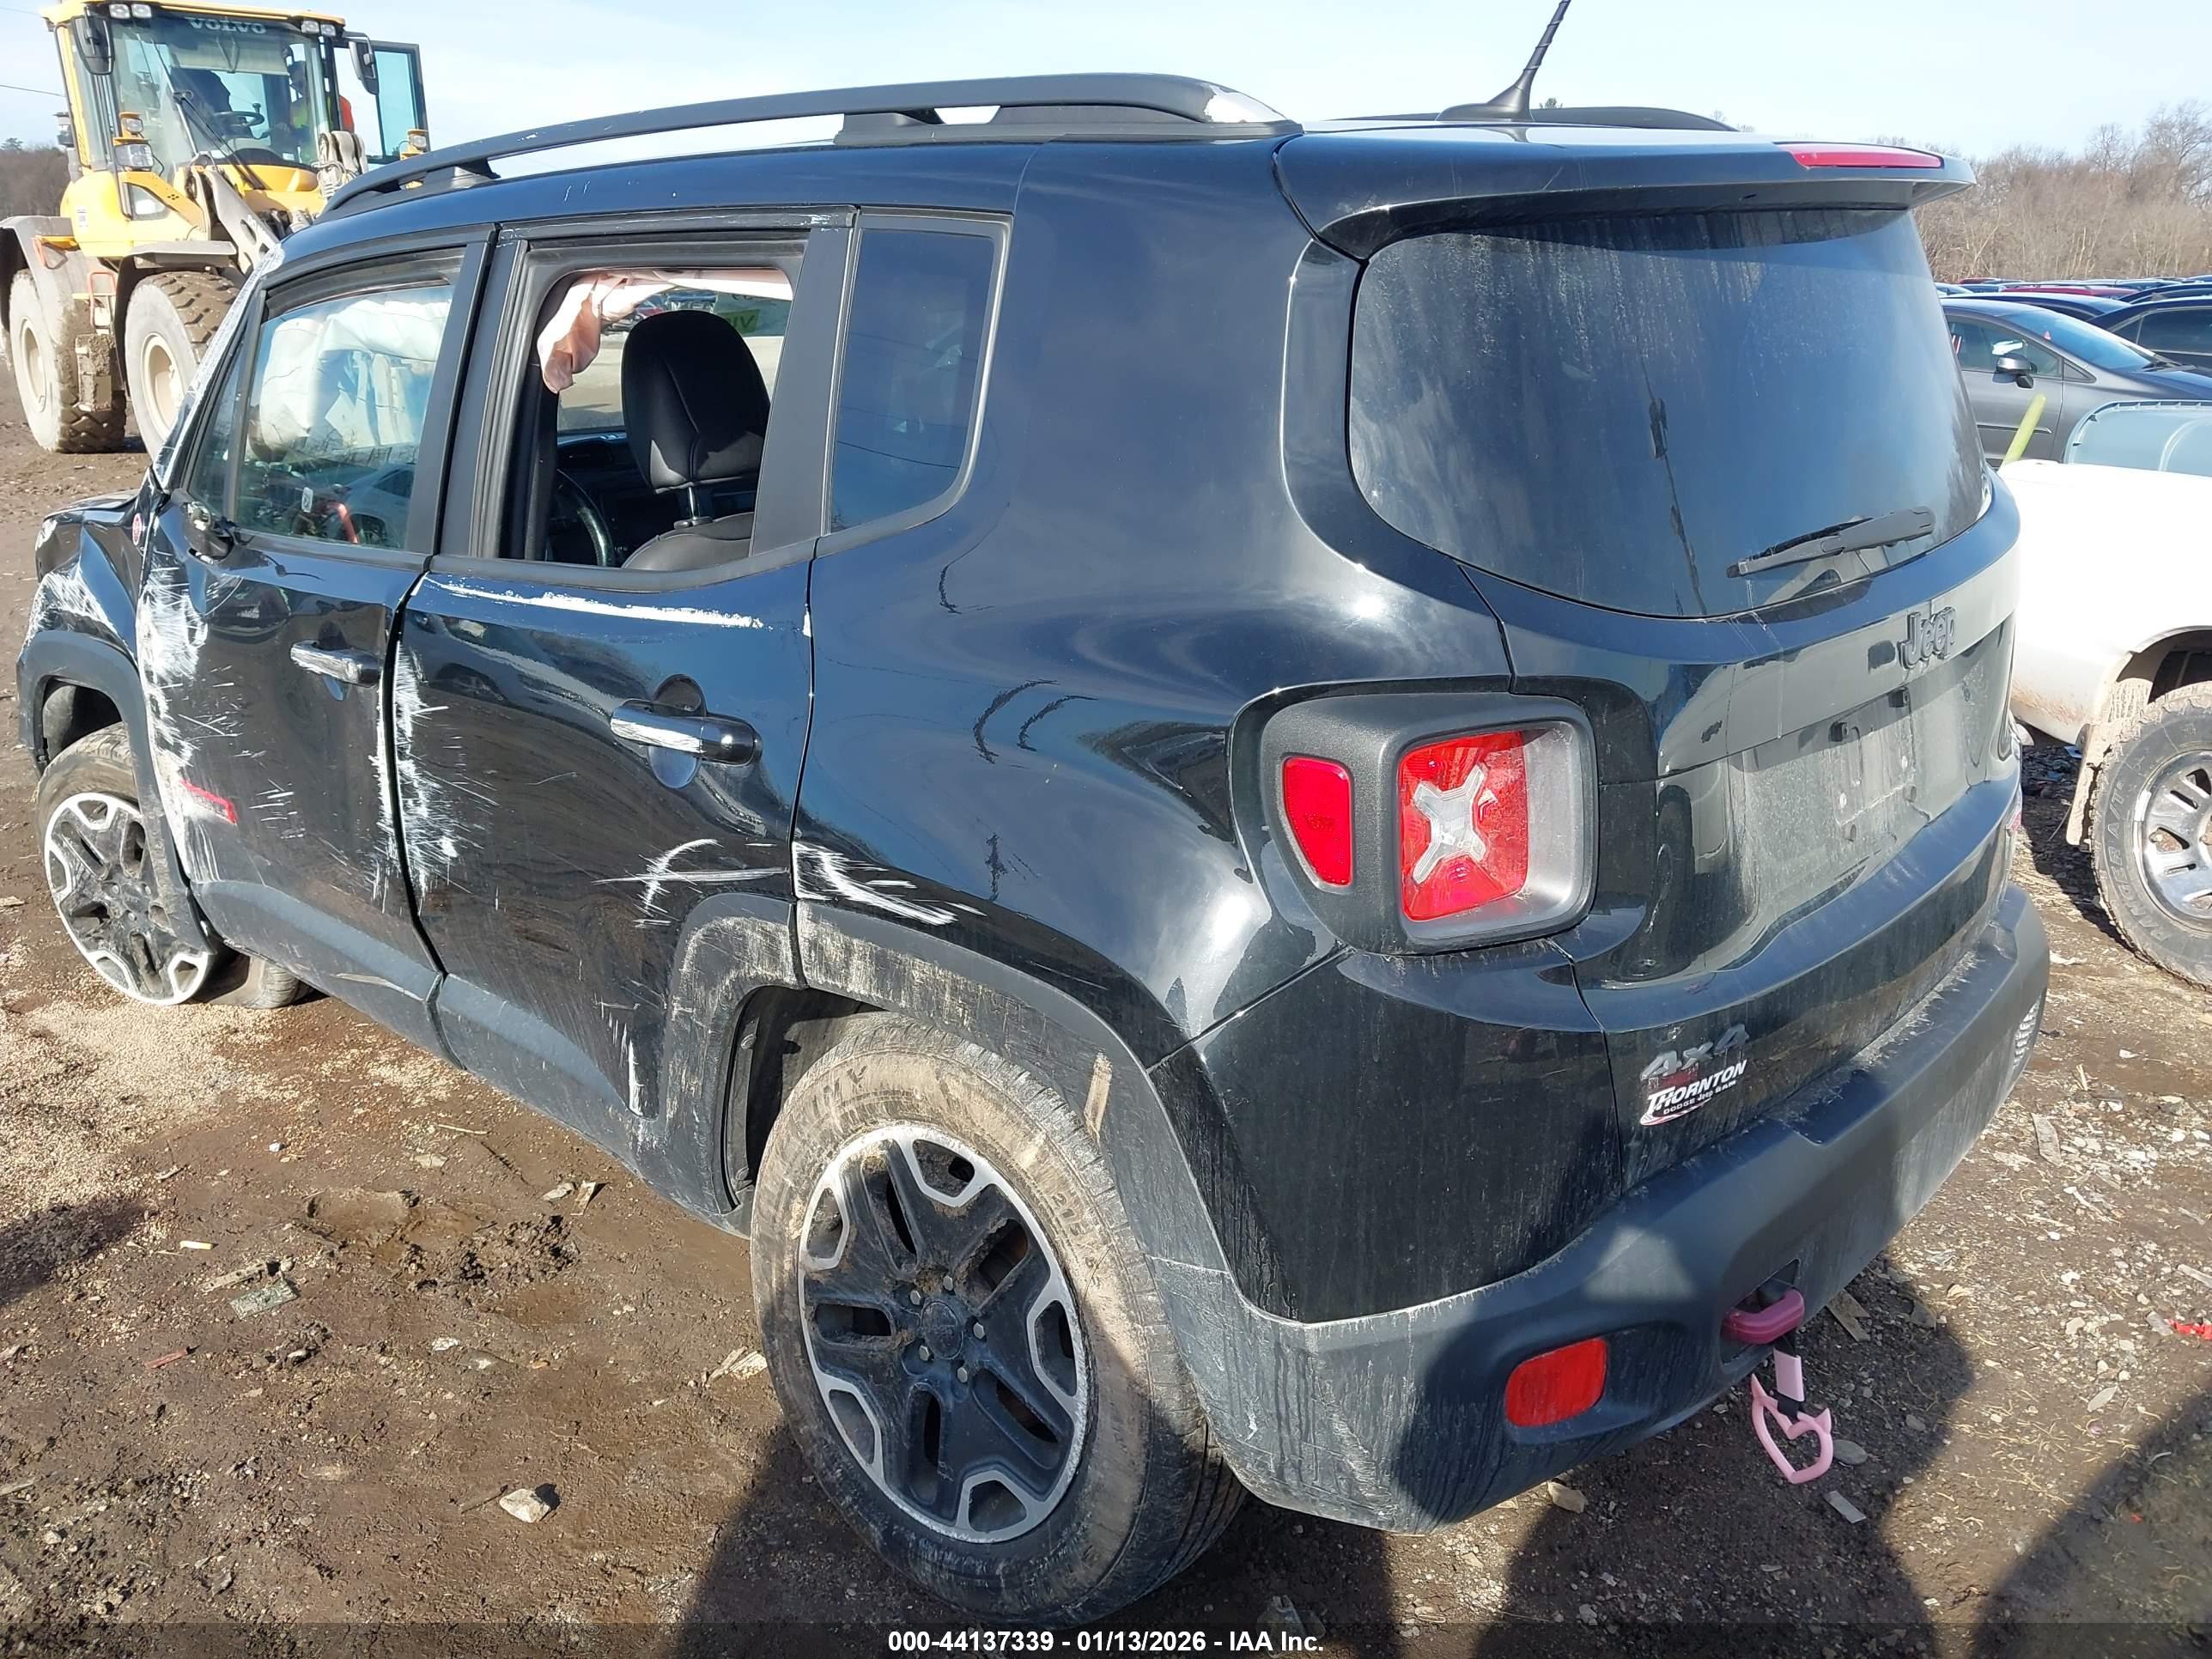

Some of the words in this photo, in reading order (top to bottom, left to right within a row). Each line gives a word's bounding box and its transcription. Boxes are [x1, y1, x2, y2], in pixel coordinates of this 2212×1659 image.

[185, 16, 267, 34] VOLVO
[1898, 606, 1956, 669] Jeep
[1647, 1059, 1747, 1115] THORNTON
[1663, 1098, 1696, 1115] DODGE
